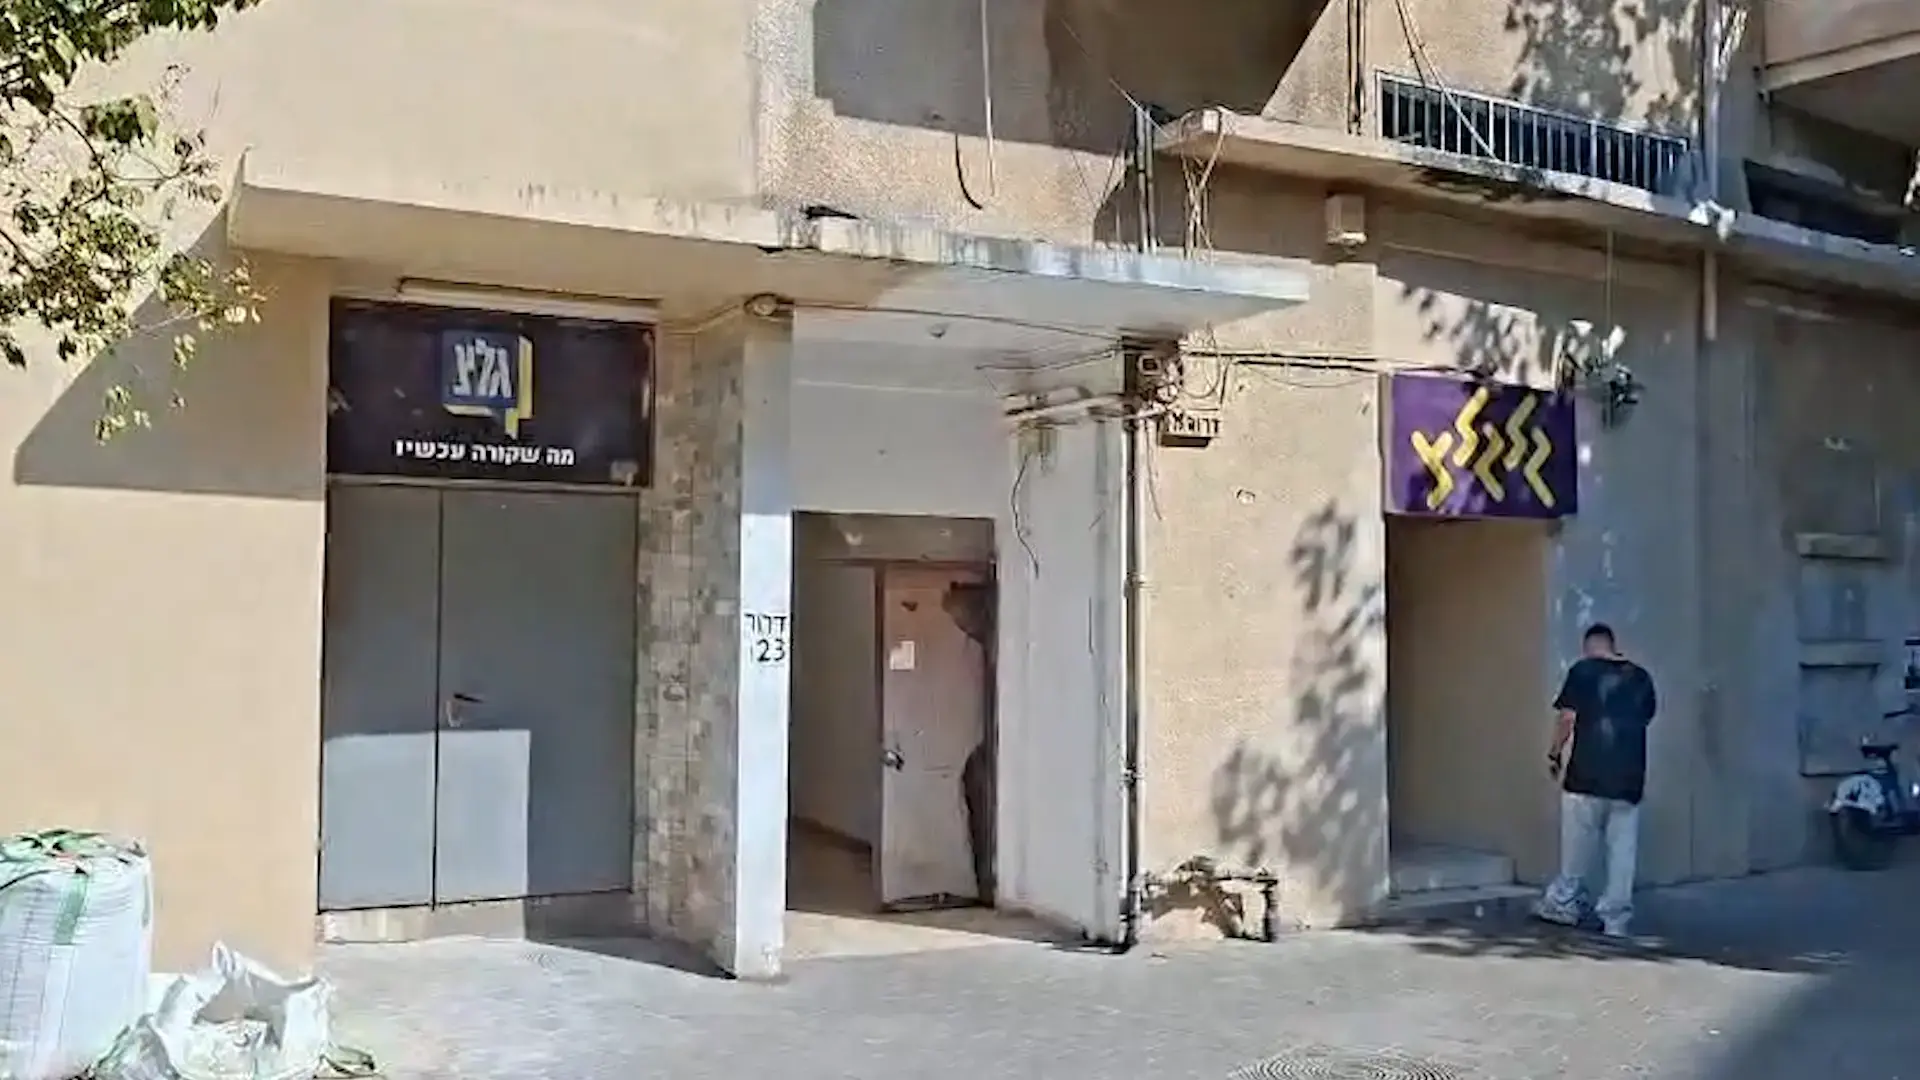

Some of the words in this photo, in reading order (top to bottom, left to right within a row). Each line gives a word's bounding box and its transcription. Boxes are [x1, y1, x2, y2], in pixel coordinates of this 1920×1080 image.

[452, 338, 512, 398] גלצ
[395, 439, 466, 461] עכשיו
[471, 443, 541, 466] שקורה
[546, 446, 575, 466] מה
[1411, 386, 1556, 510] גלגלצ
[744, 613, 787, 635] דרור
